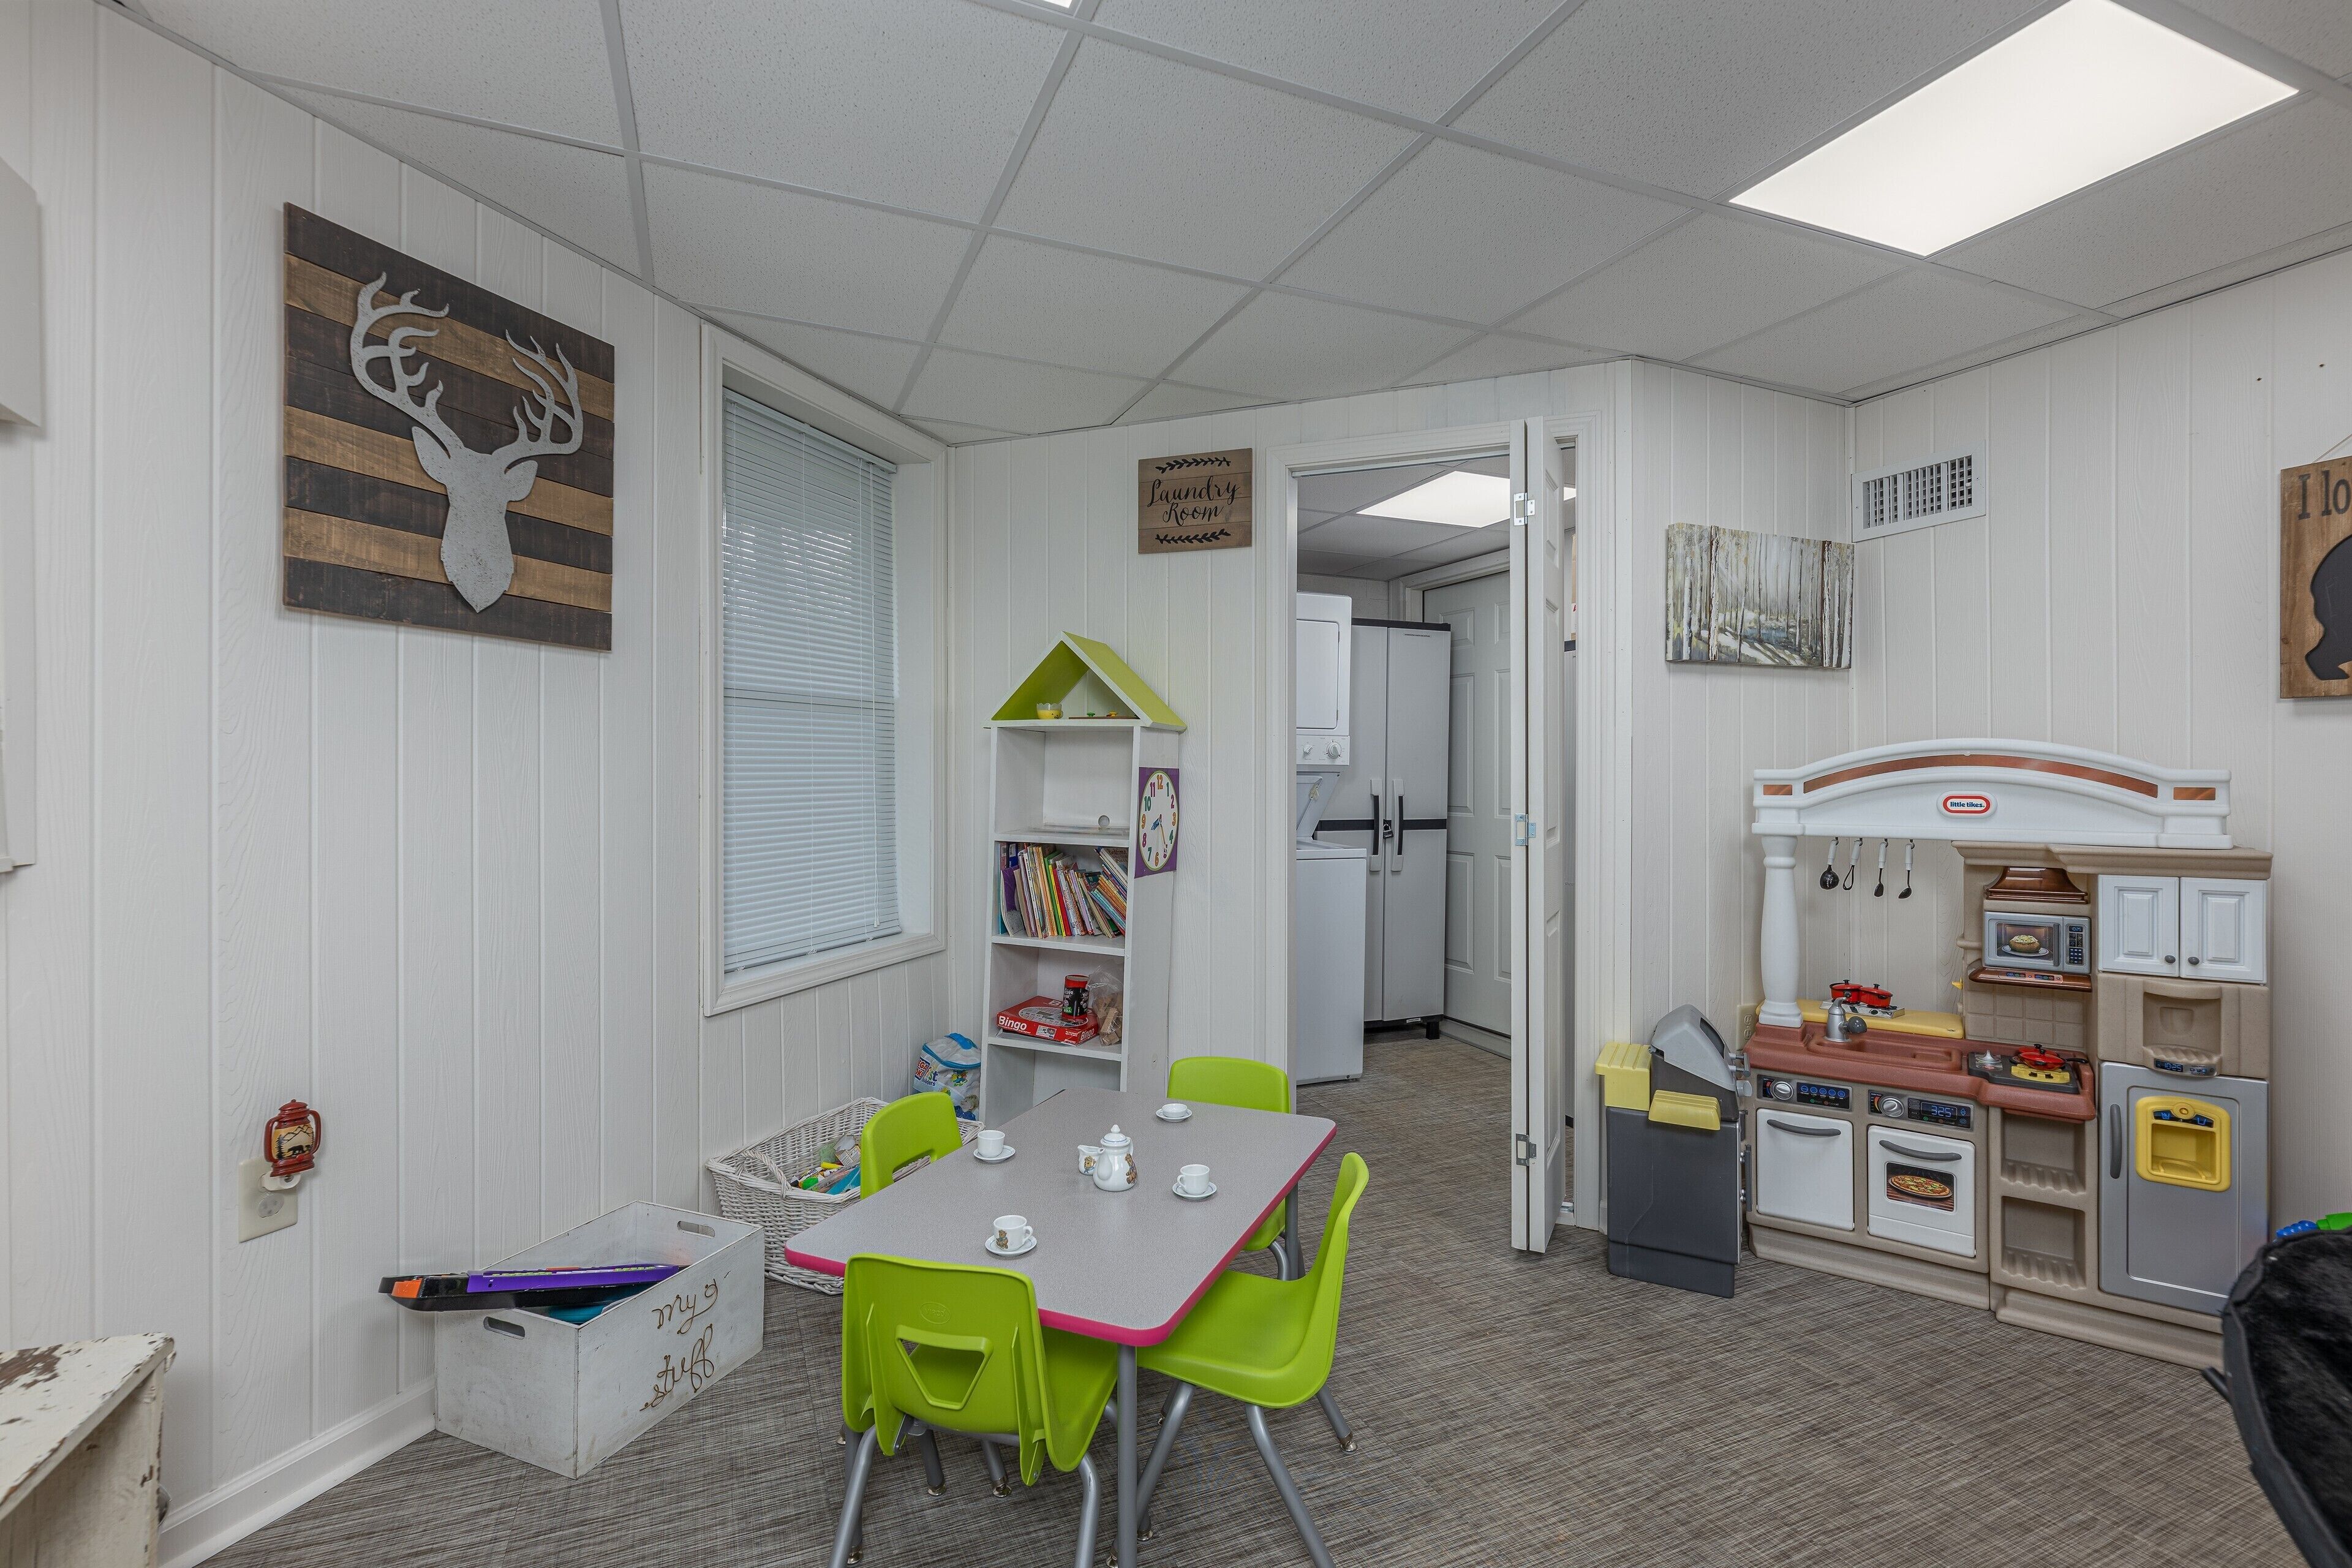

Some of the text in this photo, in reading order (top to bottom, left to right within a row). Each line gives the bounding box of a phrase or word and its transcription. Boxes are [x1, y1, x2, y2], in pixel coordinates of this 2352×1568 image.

[1147, 475, 1241, 508] Laundry
[2297, 473, 2311, 520] I
[1162, 501, 1224, 527] Room
[1150, 782, 1156, 797] 11
[1156, 774, 1164, 790] 12
[1166, 782, 1169, 797] 1
[1144, 796, 1152, 812] 10
[1170, 794, 1175, 809] 2
[1141, 813, 1146, 829] 9
[1172, 812, 1177, 826] 3
[1142, 832, 1147, 848] 8
[1169, 829, 1174, 845] 4
[1147, 846, 1152, 862] 7
[1155, 851, 1159, 867] 6
[999, 1016, 1027, 1031] Bingo
[1080, 1028, 1095, 1041] Bingo
[652, 1278, 718, 1334] my
[639, 1323, 715, 1411] stuff
